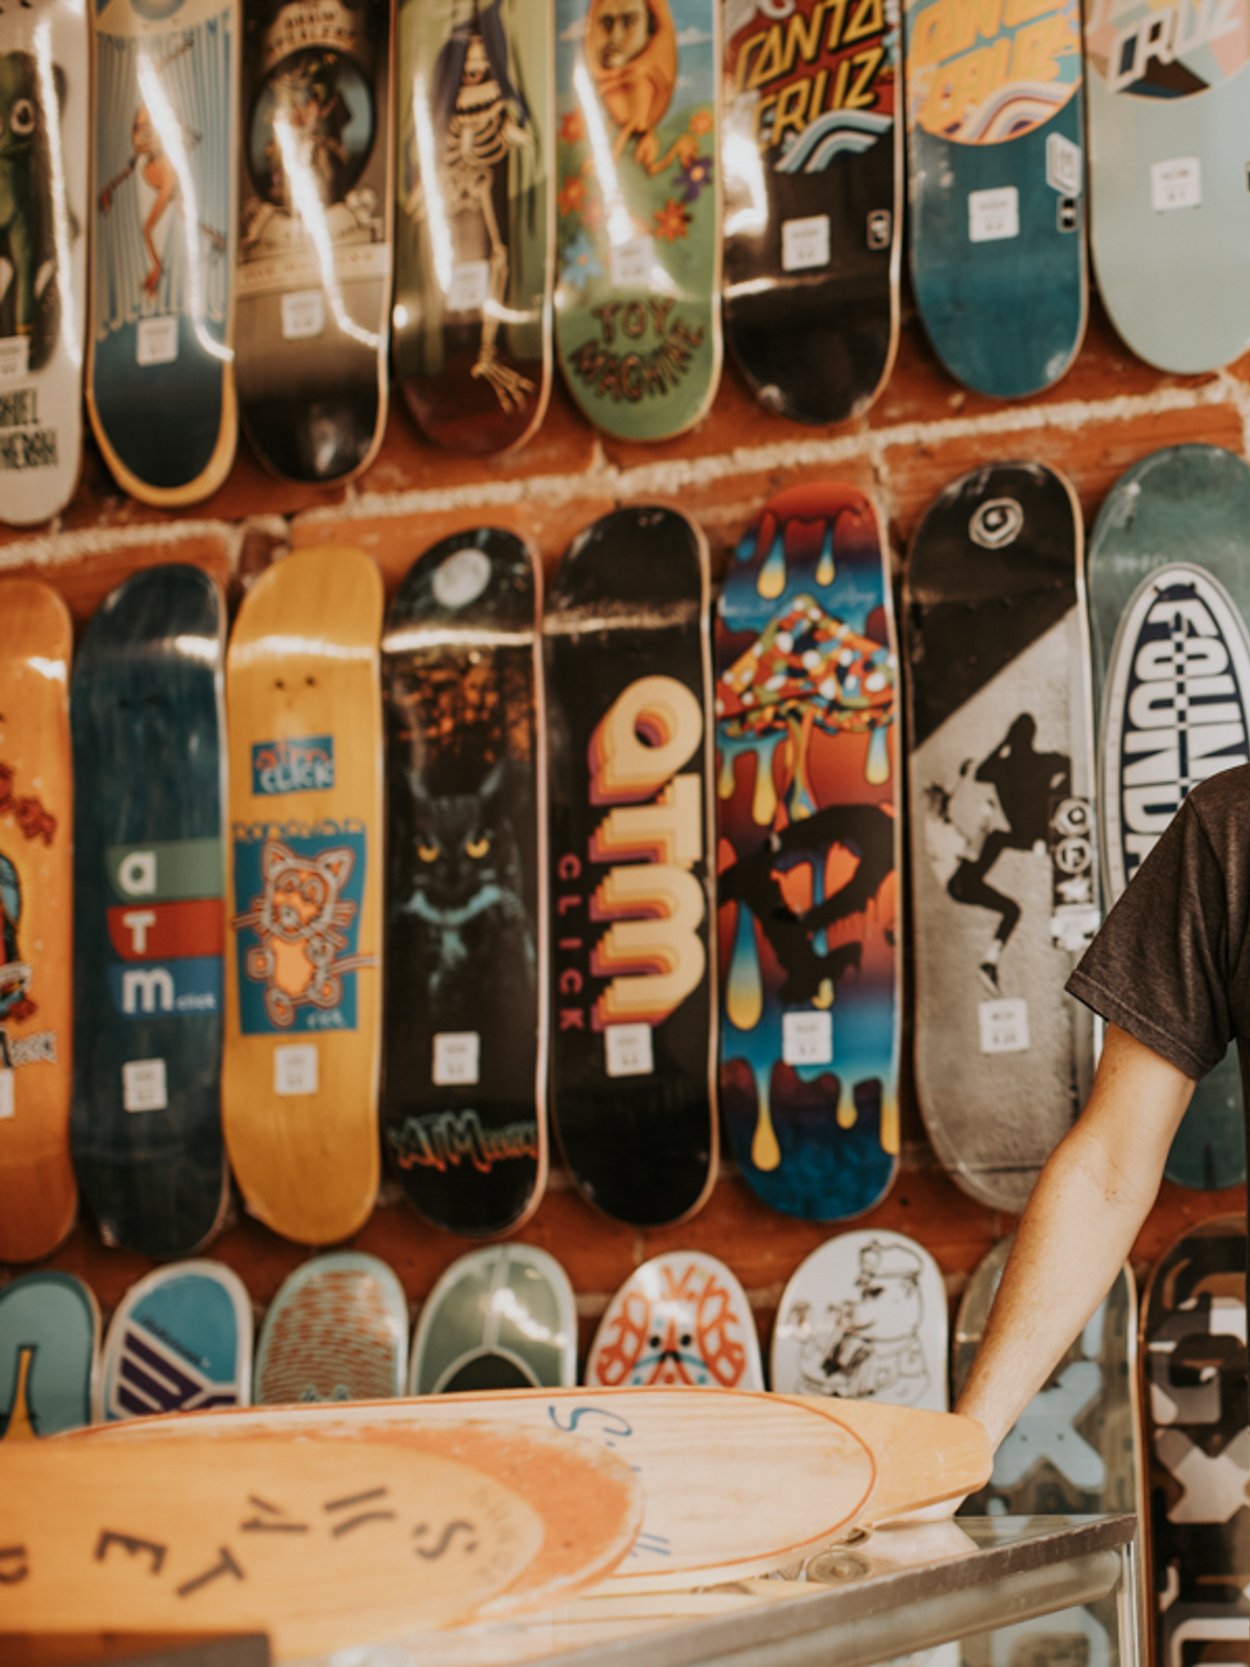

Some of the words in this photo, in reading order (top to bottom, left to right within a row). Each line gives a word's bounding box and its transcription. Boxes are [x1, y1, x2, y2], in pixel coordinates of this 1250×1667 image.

[568, 316, 706, 404] MACHINE
[591, 297, 677, 345] TOY
[558, 854, 585, 1031] CLICK
